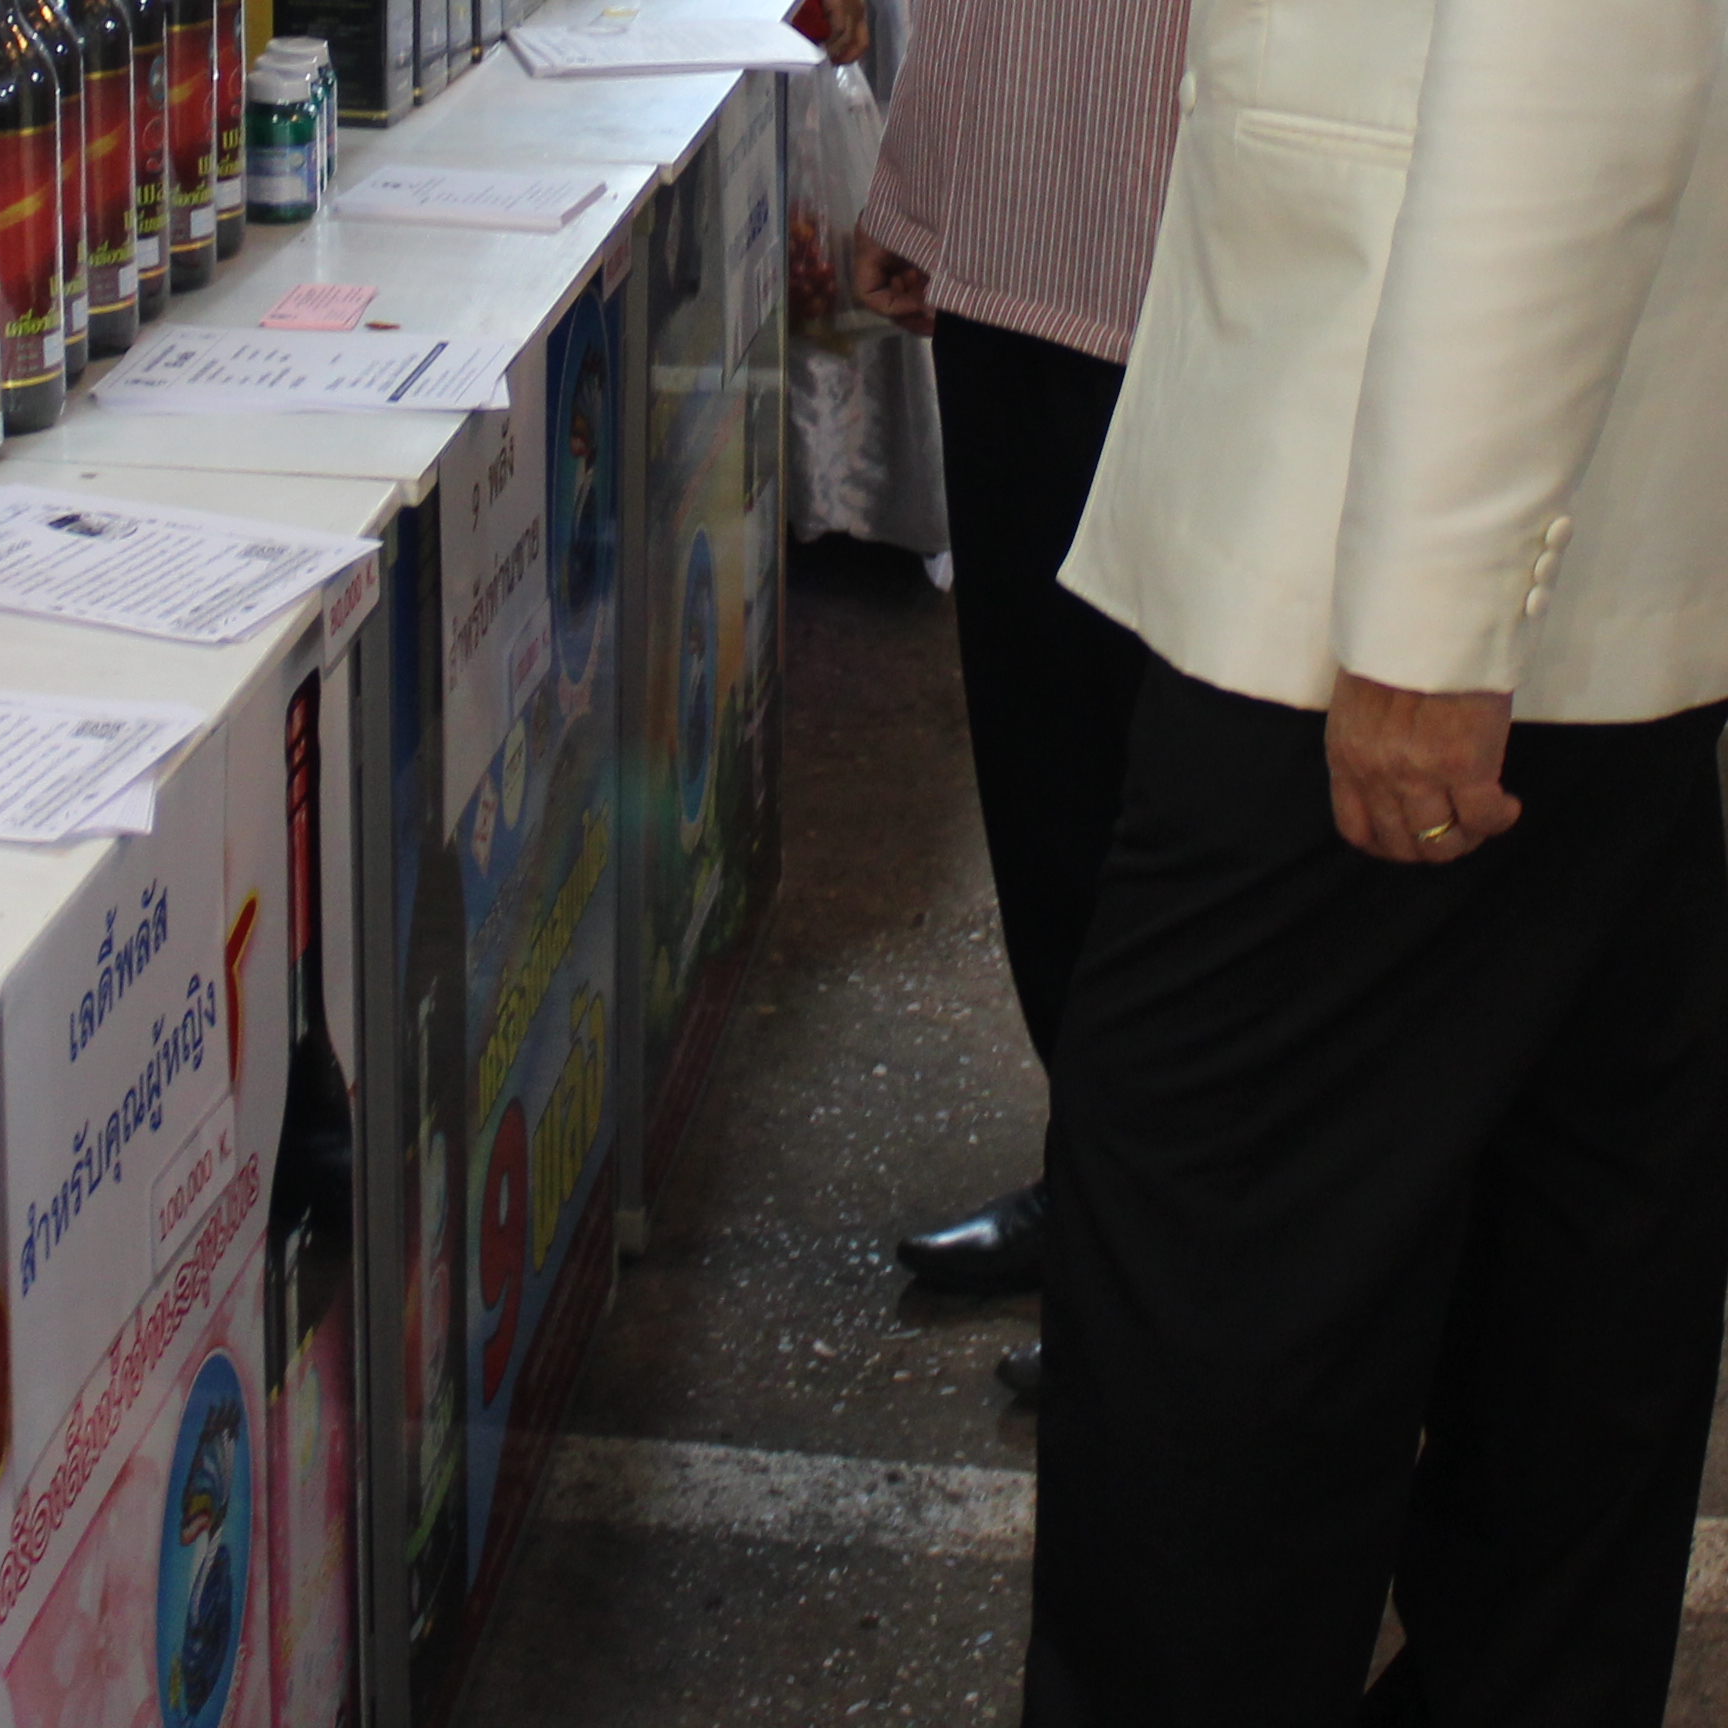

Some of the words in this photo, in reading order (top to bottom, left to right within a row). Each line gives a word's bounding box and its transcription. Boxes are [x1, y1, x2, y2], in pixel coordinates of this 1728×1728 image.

[69, 877, 170, 1065] เลดี้พลัส
[19, 972, 217, 1298] สำหรับคุณผู้หญิง
